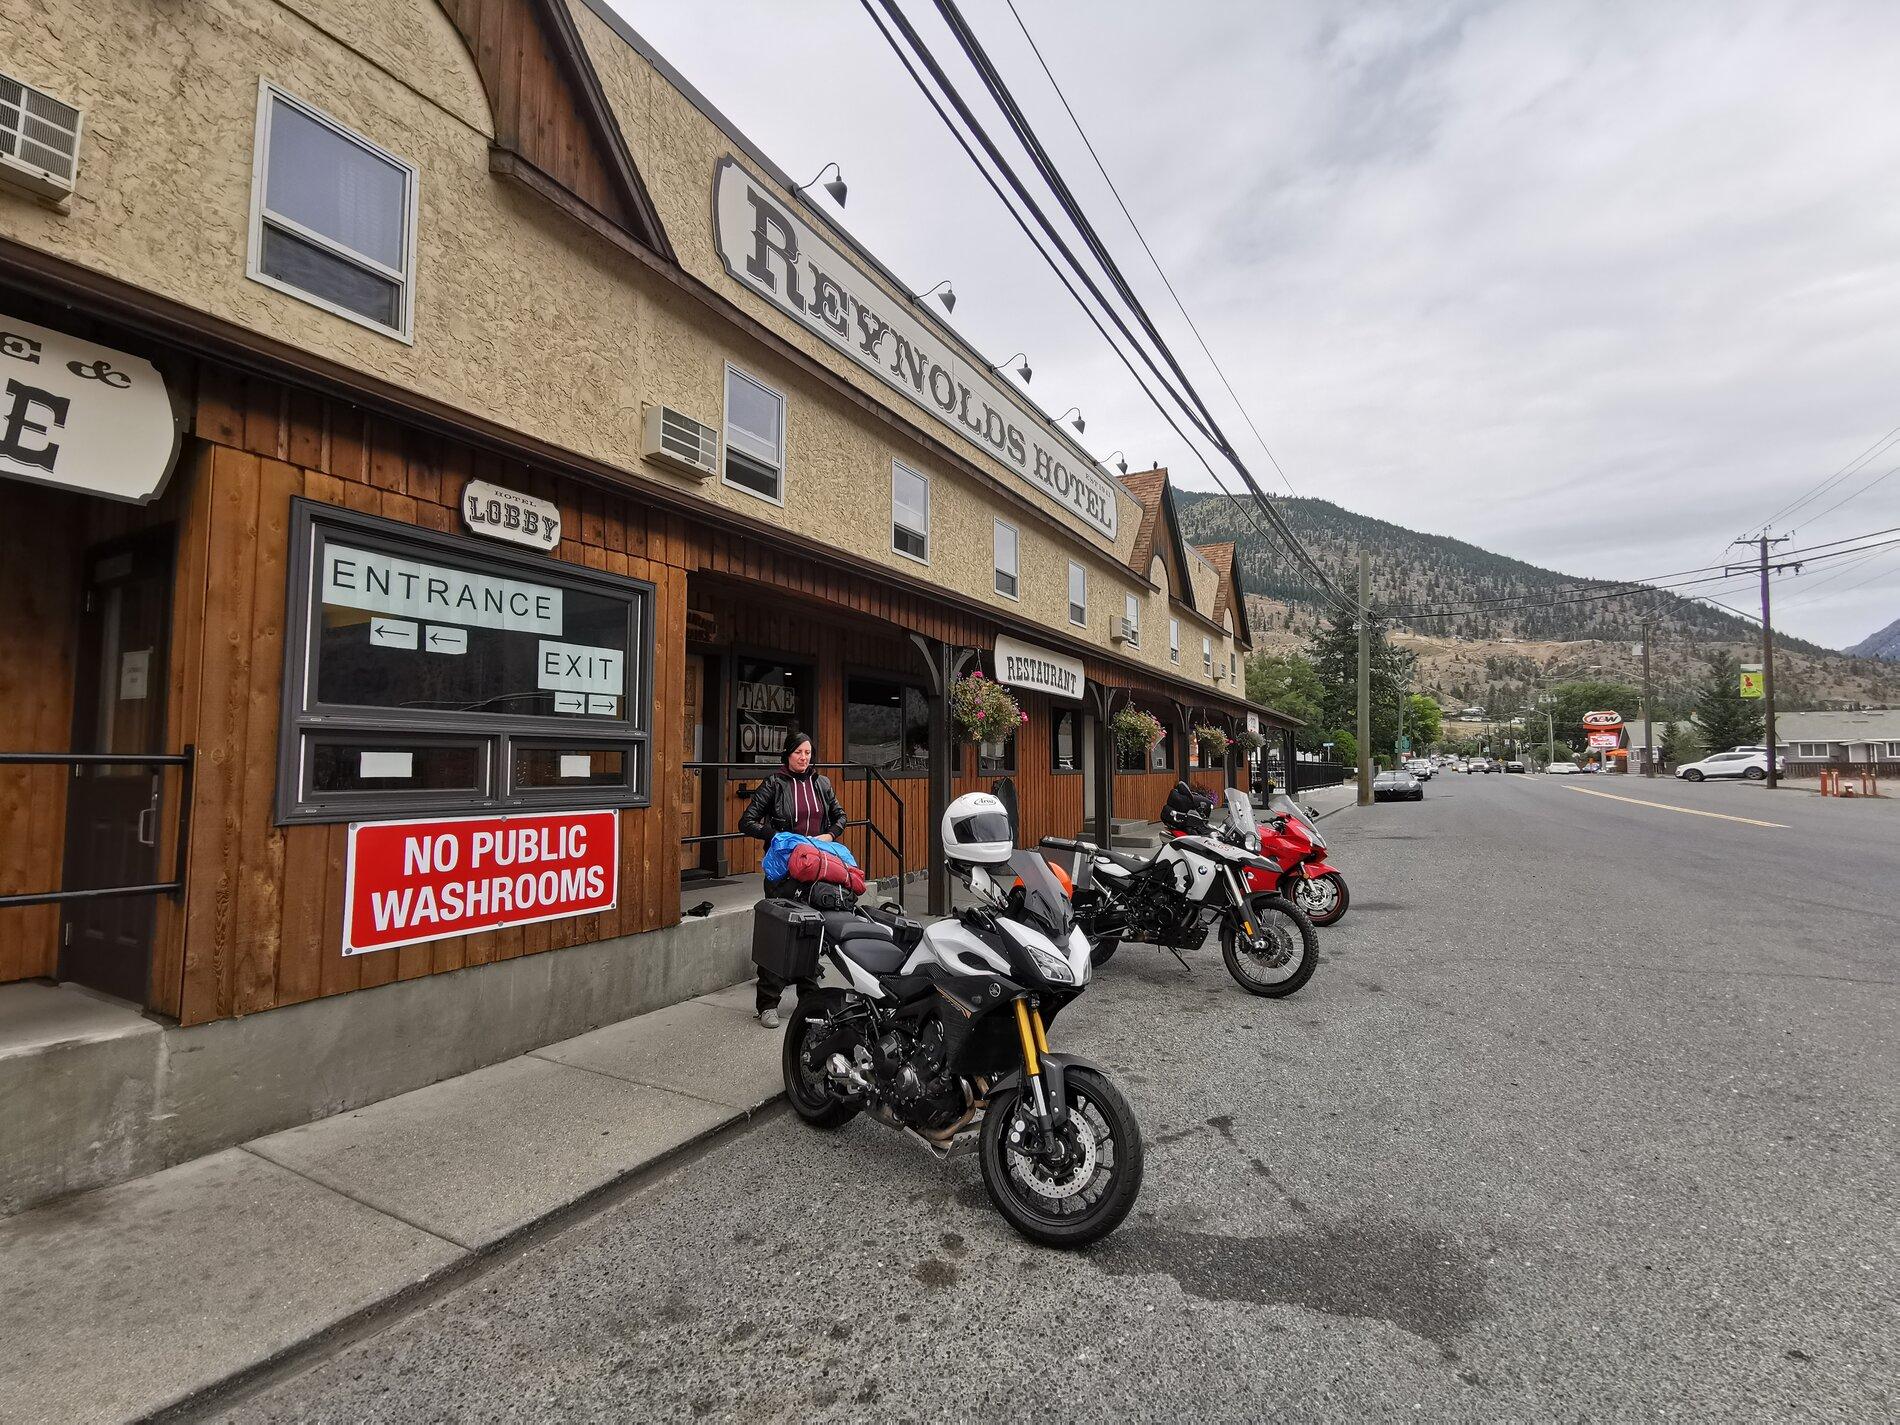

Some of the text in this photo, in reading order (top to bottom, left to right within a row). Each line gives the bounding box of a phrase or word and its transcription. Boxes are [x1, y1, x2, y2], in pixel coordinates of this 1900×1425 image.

[66, 360, 131, 389] &
[746, 184, 1113, 530] REYNOLDS HOTEL
[494, 490, 537, 508] HOTEL
[468, 495, 559, 542] LOBBY
[332, 558, 551, 620] ENTRANCE
[545, 651, 613, 681] EXIT
[1006, 655, 1077, 695] RESTAURANT
[738, 683, 796, 712] TAKE
[1590, 715, 1619, 723] A&W
[742, 725, 787, 753] OUT
[403, 824, 587, 876] NO PUBLIC
[371, 865, 605, 932] WASHROOMS
